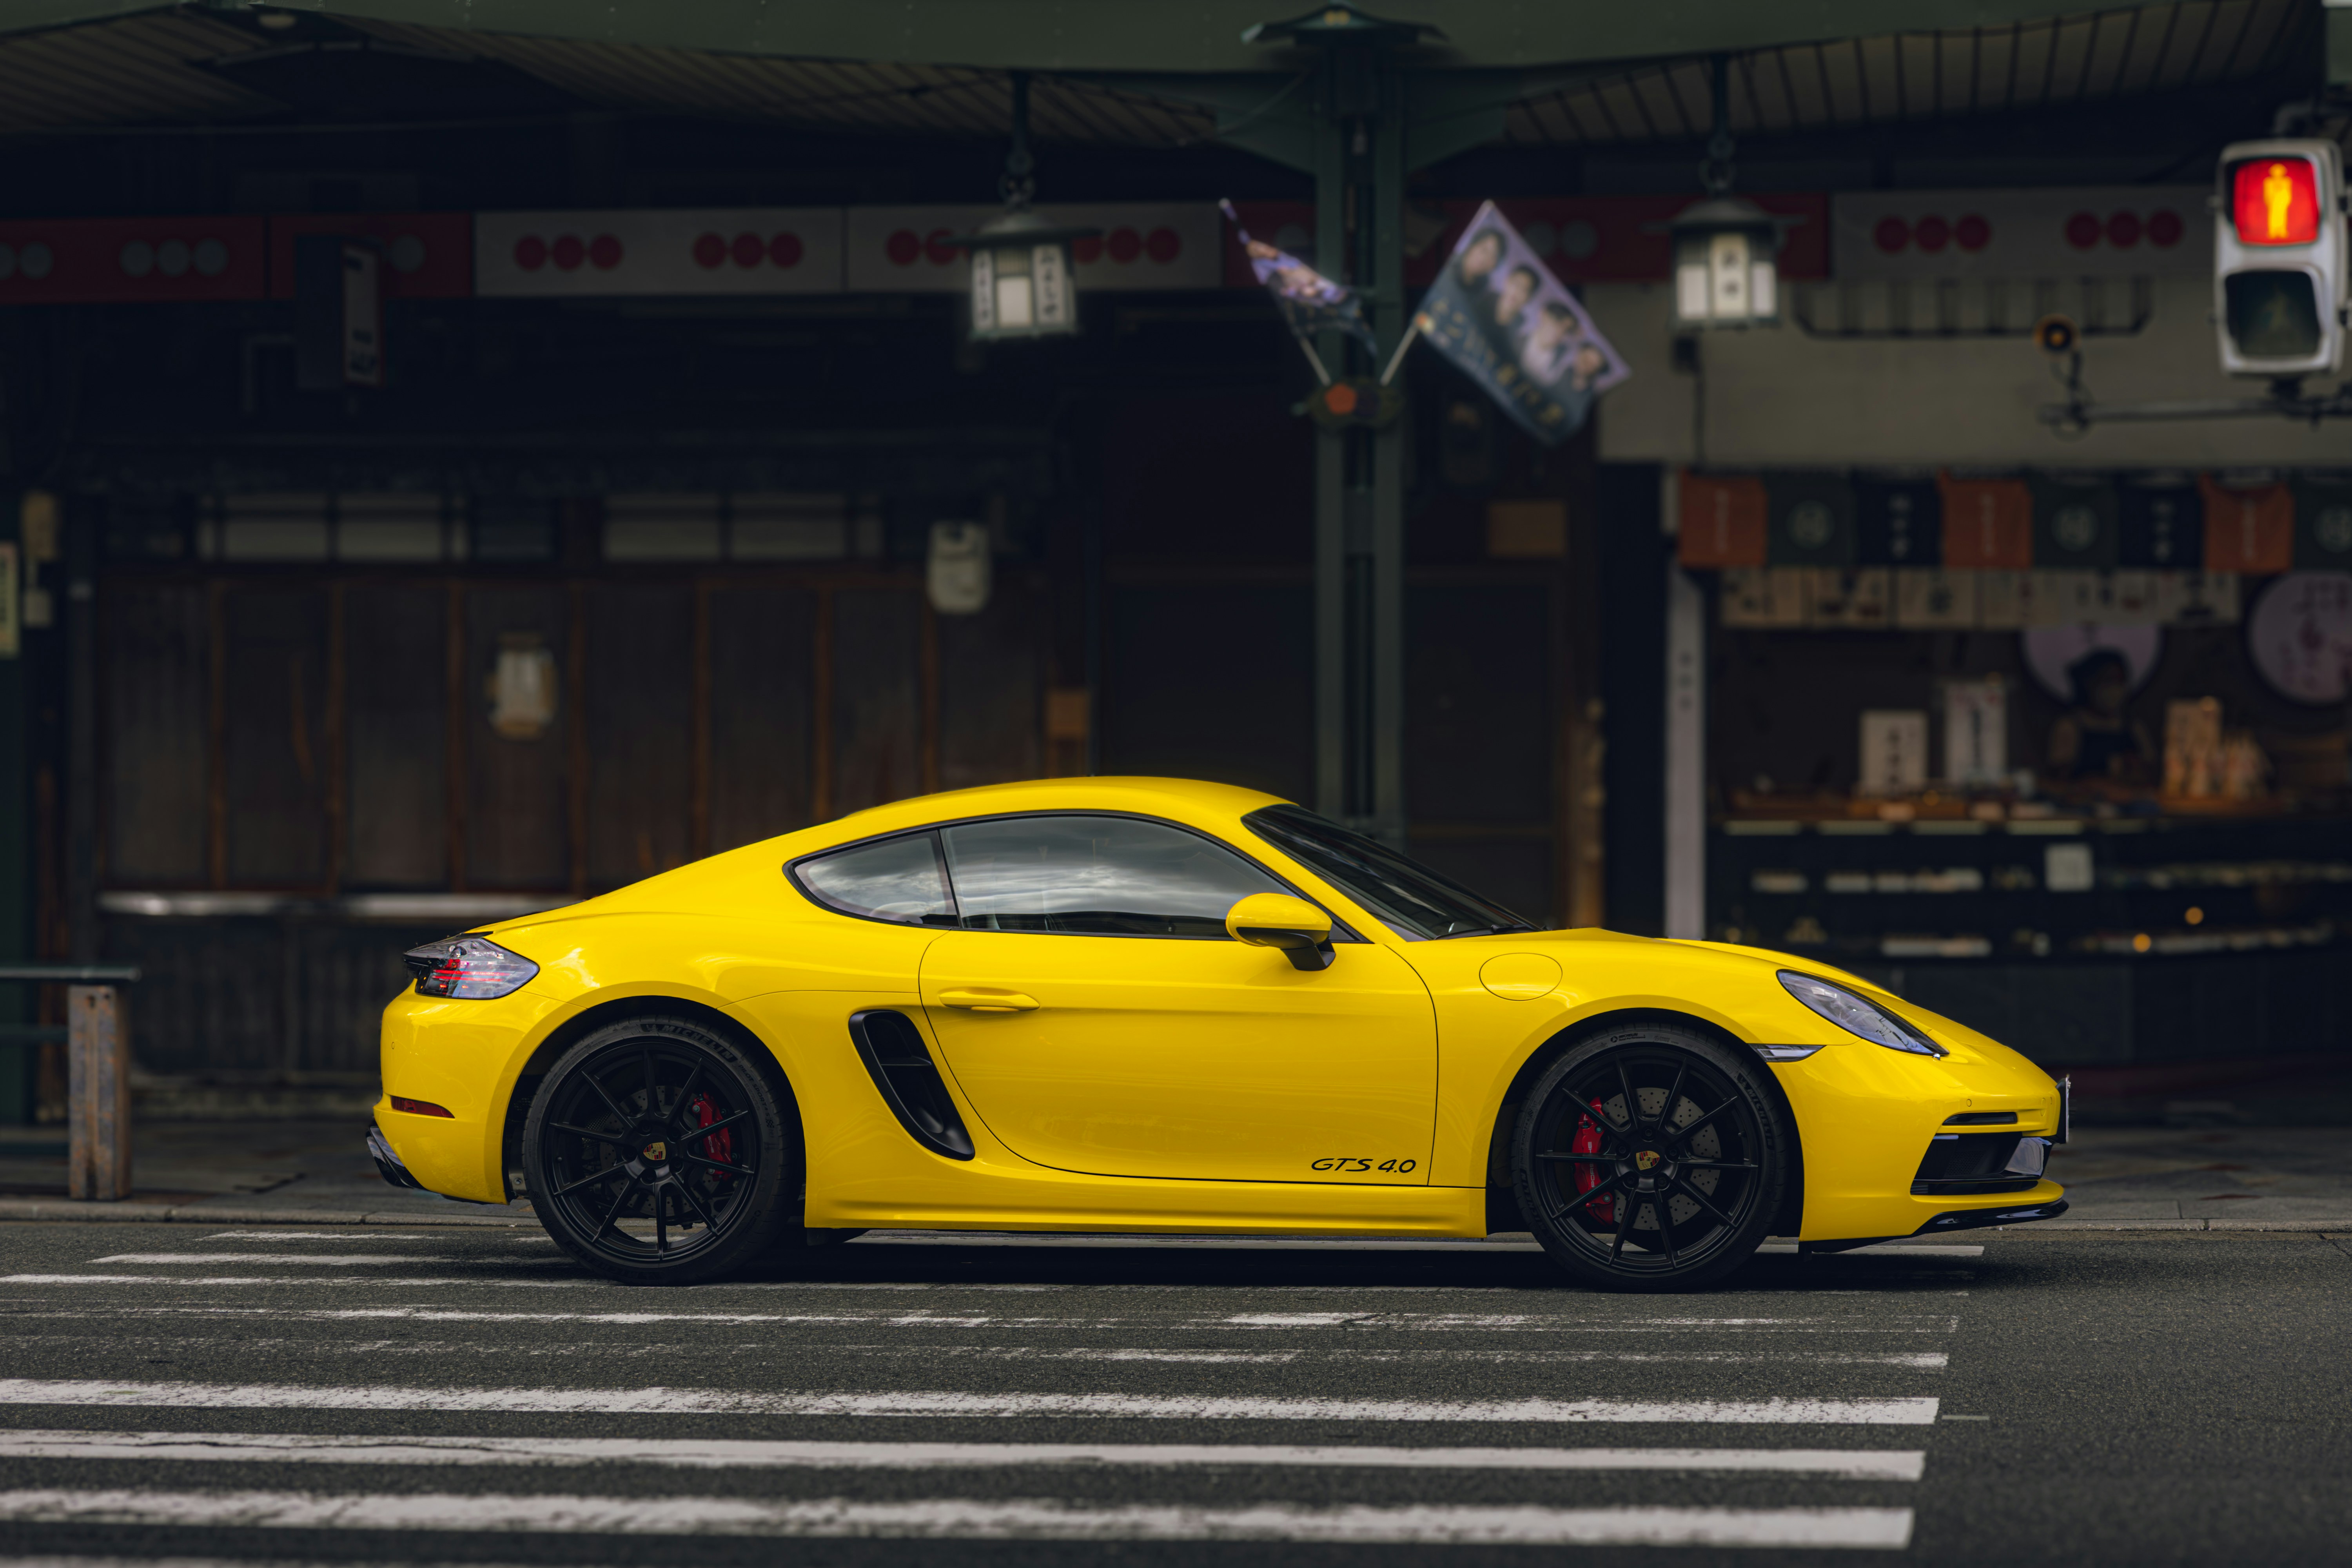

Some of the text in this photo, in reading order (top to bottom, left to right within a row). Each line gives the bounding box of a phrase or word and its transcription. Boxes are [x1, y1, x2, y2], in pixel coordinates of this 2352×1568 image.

[662, 1025, 733, 1059] MICHELIN
[739, 1065, 754, 1082] PILOT
[753, 1084, 767, 1106] SPORT
[1747, 1089, 1773, 1146] MICHELIN
[1311, 1158, 1416, 1173] GTS 4.0
